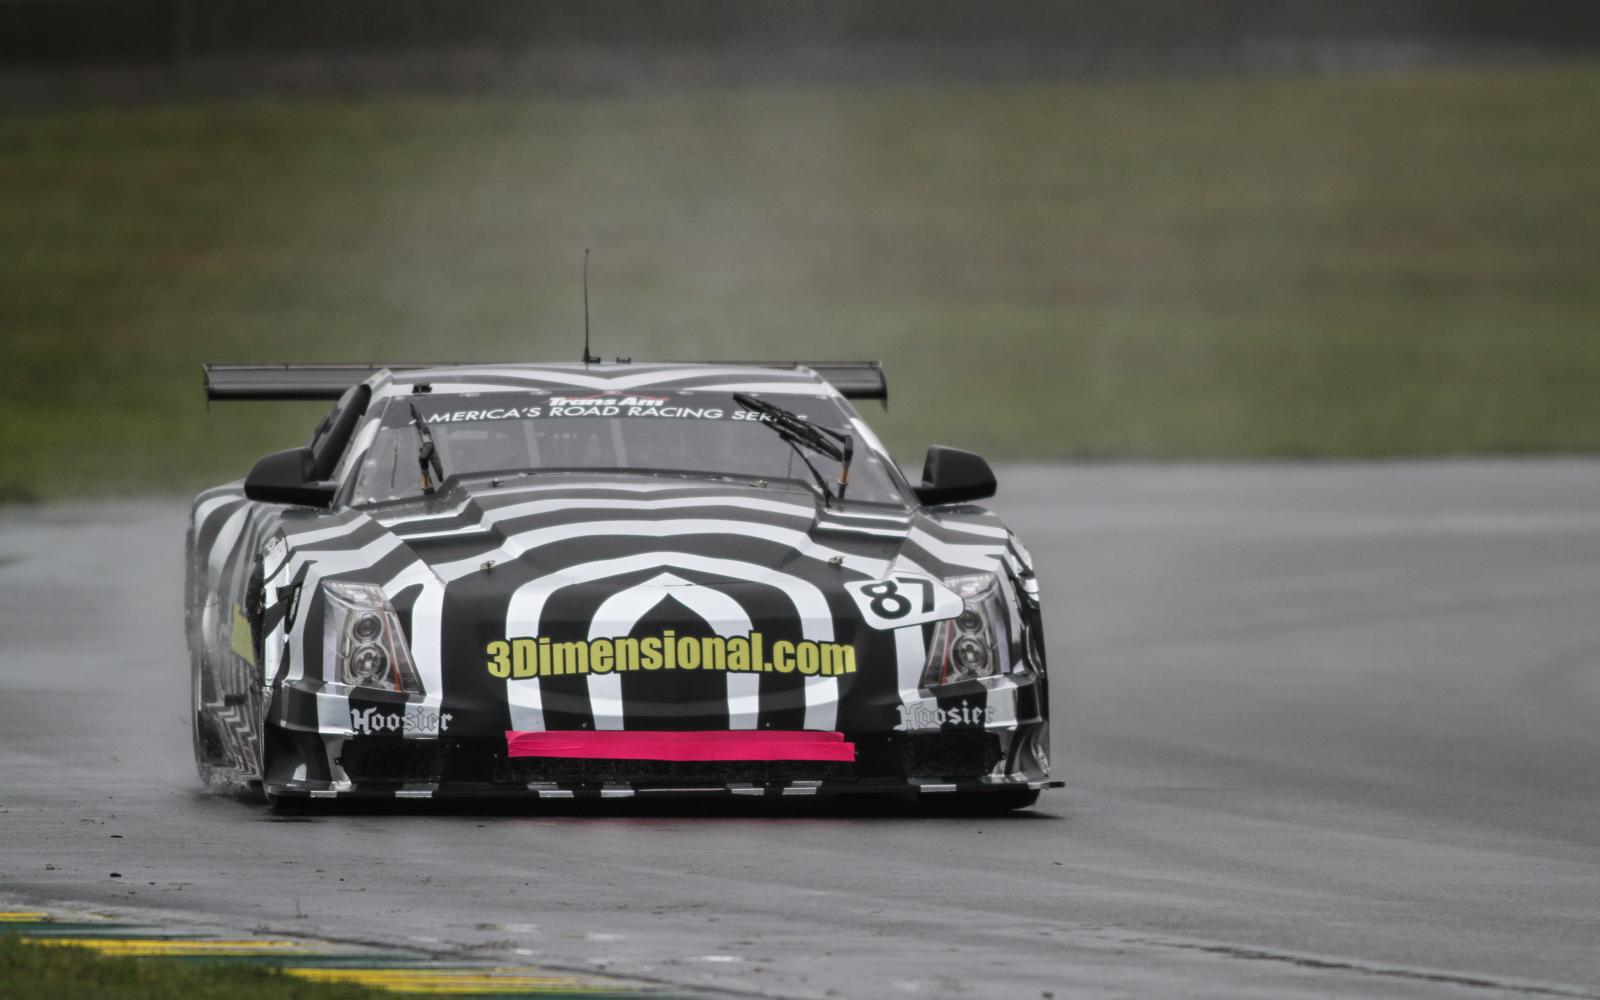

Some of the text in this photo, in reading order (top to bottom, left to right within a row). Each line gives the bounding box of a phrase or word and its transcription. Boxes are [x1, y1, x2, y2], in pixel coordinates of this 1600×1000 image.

[550, 406, 619, 417] ROAD
[628, 406, 724, 418] RACING
[731, 410, 807, 423] SER
[860, 577, 934, 619] 87
[486, 630, 856, 679] 3Dimensional.com
[351, 705, 453, 735] Hoosier
[893, 700, 997, 731] Hoosier
